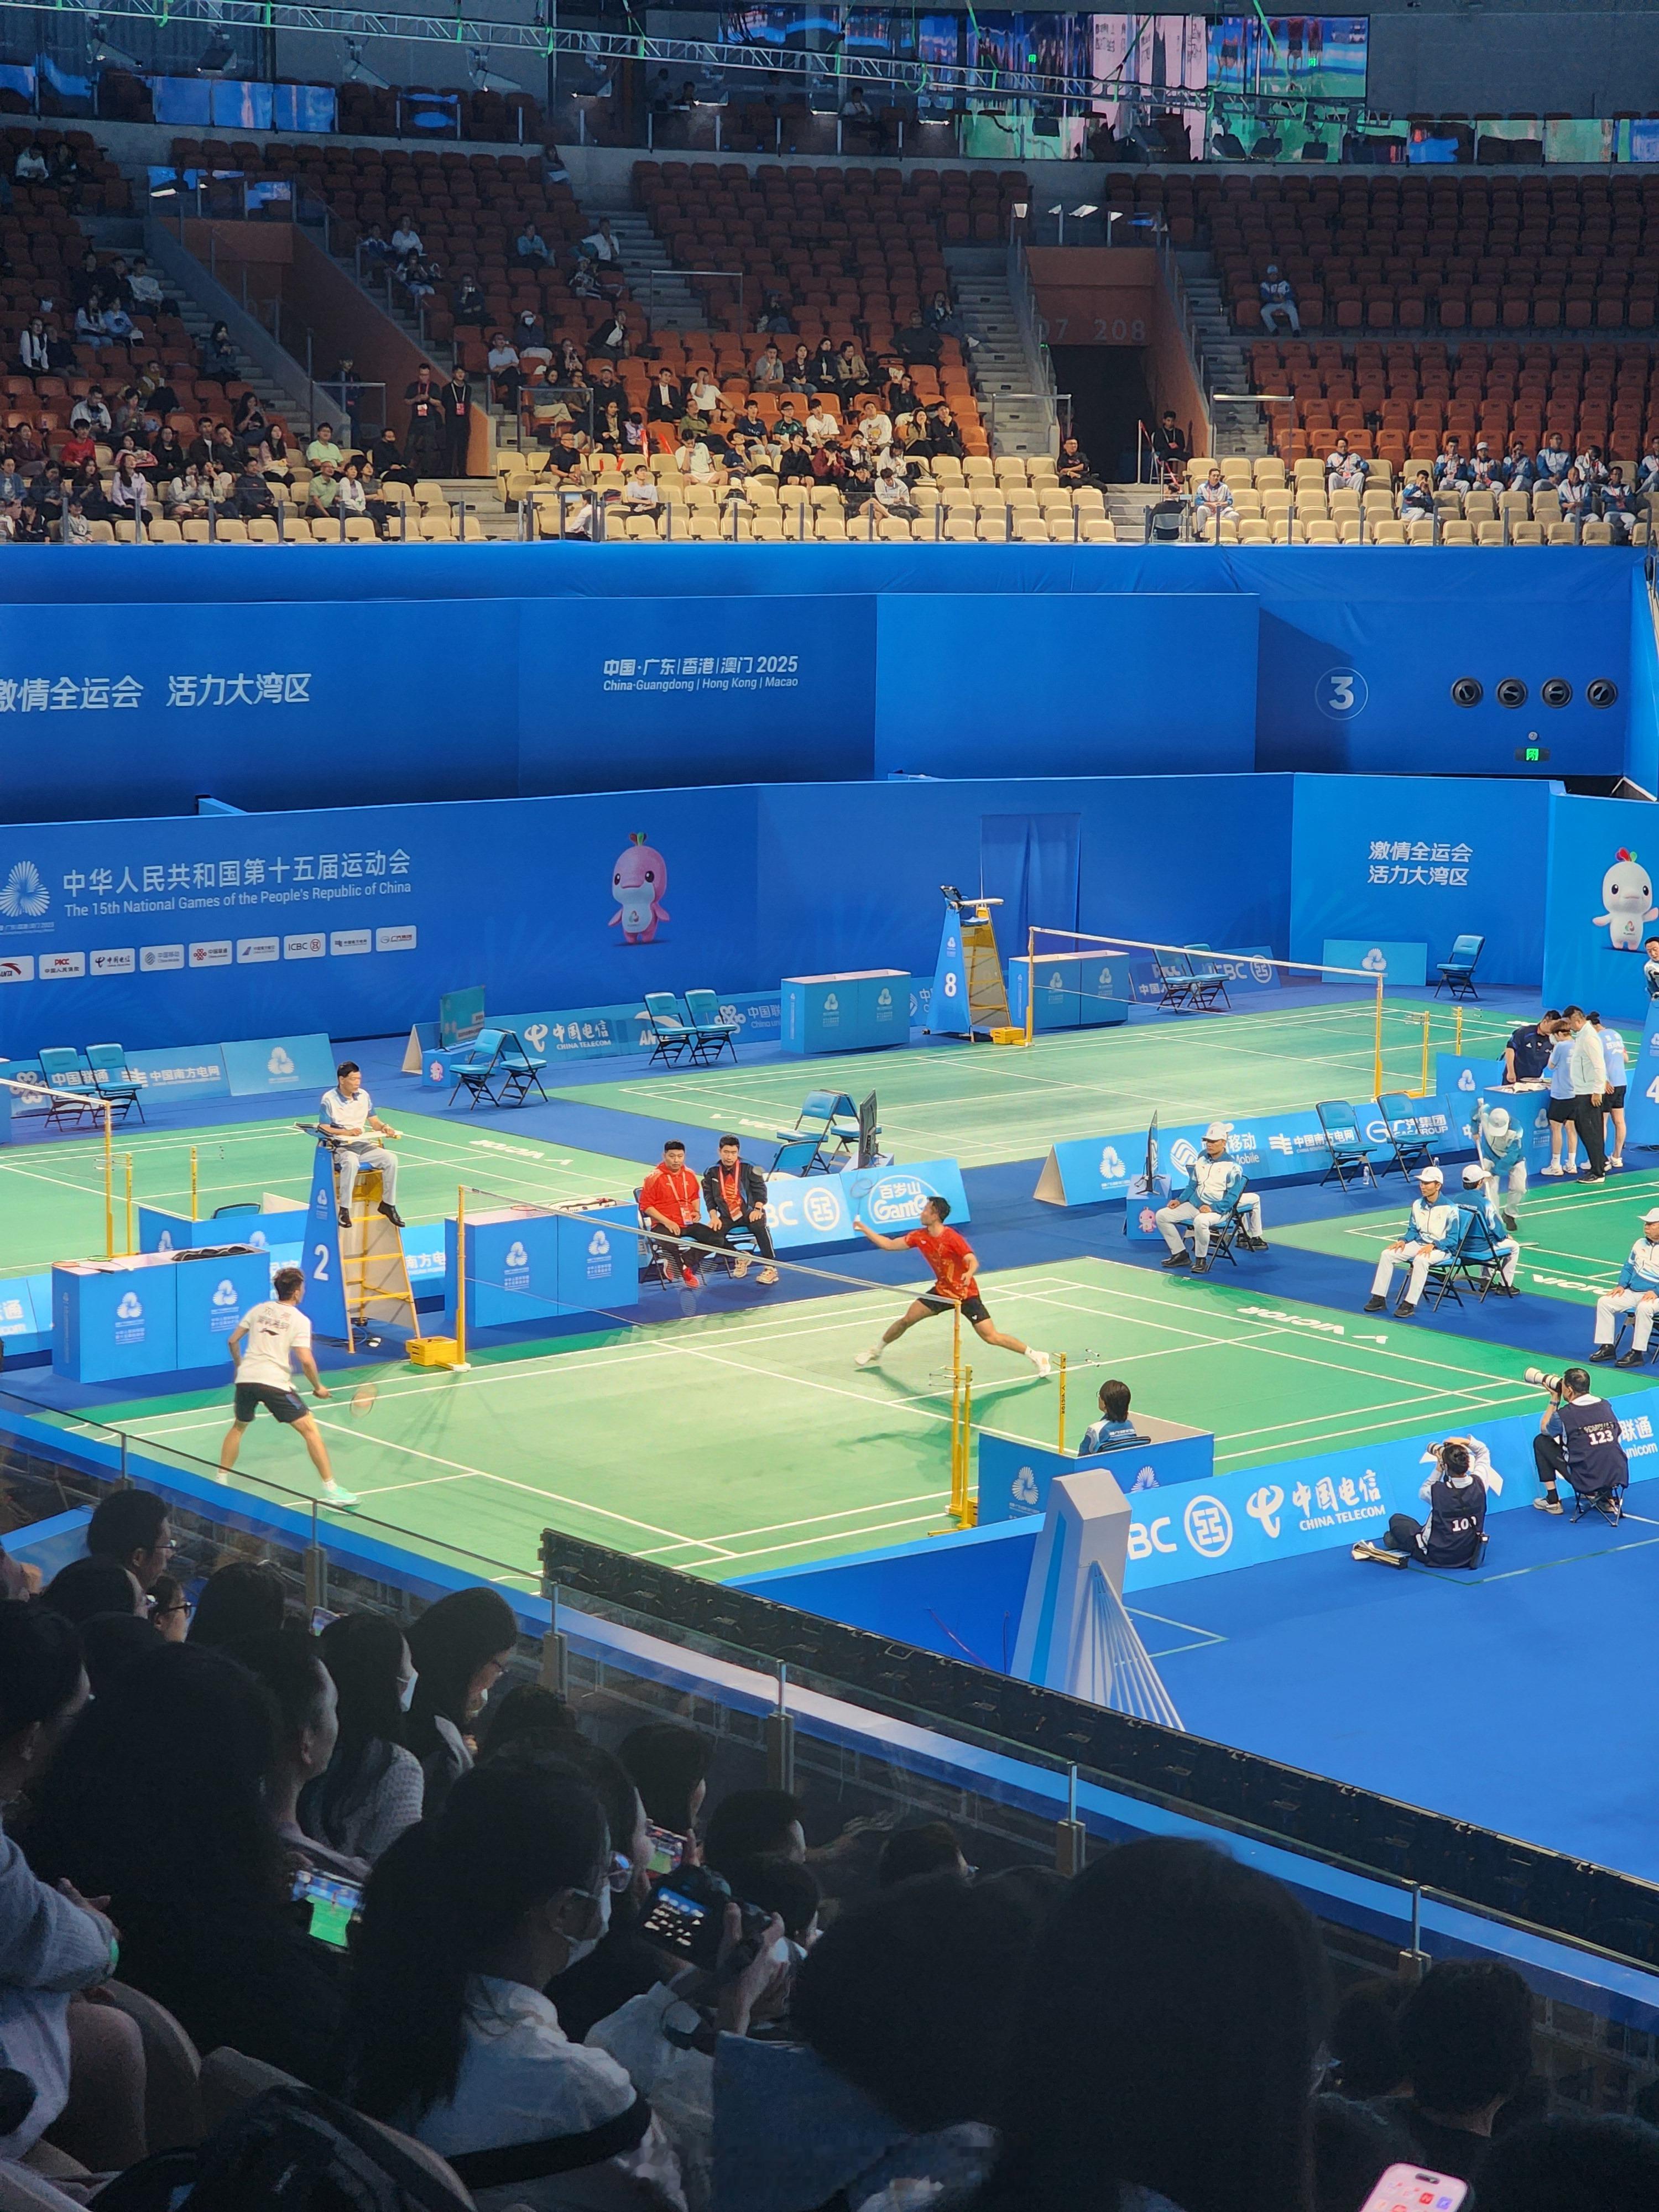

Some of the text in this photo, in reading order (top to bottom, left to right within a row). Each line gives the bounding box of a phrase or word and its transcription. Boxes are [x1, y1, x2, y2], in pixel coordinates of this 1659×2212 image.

[1093, 319, 1146, 341] 208
[756, 656, 799, 673] 2025
[166, 672, 311, 707] 活力大湾区
[702, 679, 729, 691] Hong
[731, 678, 757, 690] Kong
[765, 677, 799, 687] Macao
[1329, 676, 1354, 710] 3
[1368, 841, 1473, 863] 激情全运会
[63, 848, 410, 898] 中华人民共和国第十五届运动会
[1368, 865, 1469, 886] 活力大湾区
[64, 881, 411, 917] The 15th National Games of the People's Republic of China
[288, 943, 308, 951] ICBC
[945, 972, 957, 997] 8
[553, 1020, 609, 1042] 中国电信
[557, 1040, 612, 1050] CHINA TELECOM
[150, 1066, 220, 1082] 中国南方电网
[1293, 1129, 1355, 1148] 中国南方电网
[879, 1181, 921, 1199] 百岁山
[314, 1244, 329, 1281] 2
[1237, 1306, 1344, 1335] VICTOR
[1588, 1430, 1614, 1446] 123
[1292, 1469, 1381, 1517] 中国电信
[1299, 1504, 1386, 1531] CHINA TELECOM
